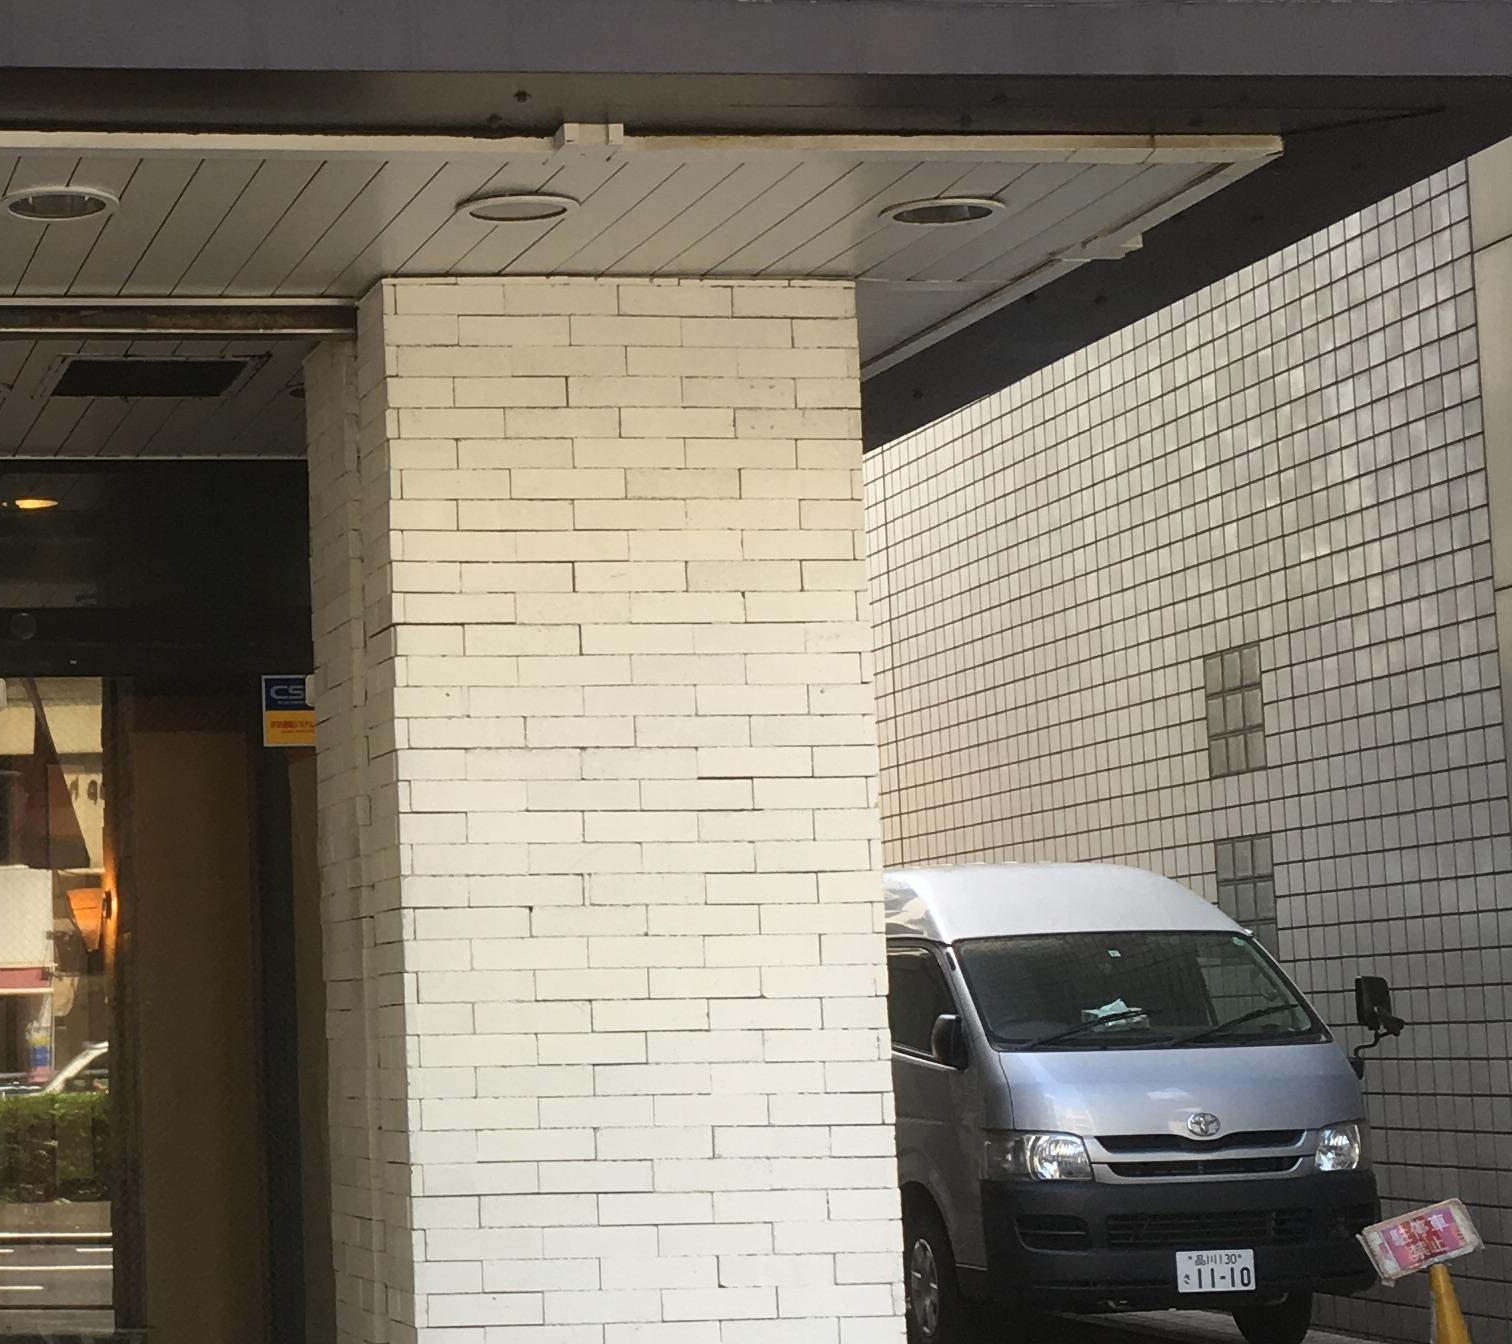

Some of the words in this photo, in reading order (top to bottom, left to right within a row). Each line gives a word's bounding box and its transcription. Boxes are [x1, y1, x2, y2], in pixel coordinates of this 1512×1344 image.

[1389, 1213, 1450, 1247] 駐停車
[1407, 1235, 1449, 1262] 禁止
[1197, 1266, 1251, 1289] 11-10
